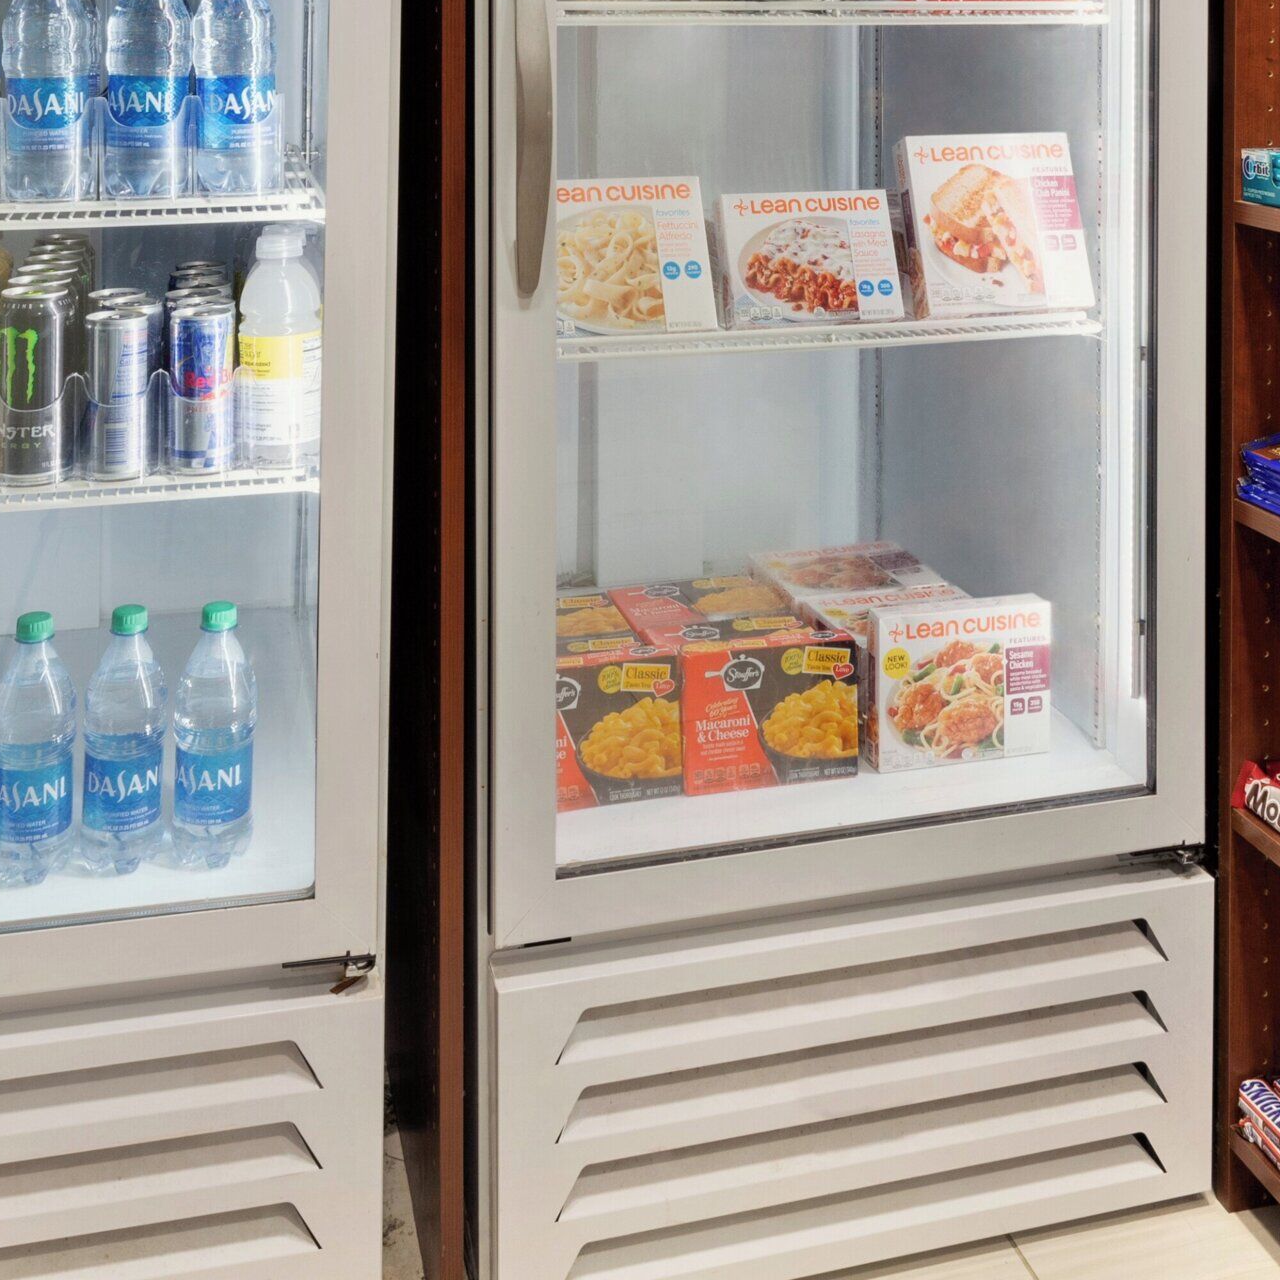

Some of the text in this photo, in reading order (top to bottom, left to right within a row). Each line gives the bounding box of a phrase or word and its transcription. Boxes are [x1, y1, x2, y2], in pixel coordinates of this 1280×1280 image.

[8, 88, 85, 121] DASANI
[930, 143, 1063, 163] Lean cuisine
[1243, 156, 1269, 179] Orbit
[605, 183, 691, 202] cuisine
[751, 196, 881, 215] Lean cuisine
[656, 208, 691, 218] favorites
[656, 220, 699, 231] Fettuccini
[658, 231, 693, 241] Alfredo
[851, 230, 886, 241] Lasagna
[867, 238, 888, 247] Meat
[854, 248, 878, 258] Sauce
[833, 594, 883, 606] Lean
[906, 611, 1041, 641] Lean cuisine
[1009, 635, 1046, 644] FEATURES
[807, 649, 847, 663] Classic
[887, 654, 905, 663] NEW
[1009, 650, 1034, 660] Sesame
[885, 661, 908, 671] LOOK!
[1009, 660, 1034, 669] Chicken
[624, 666, 668, 680] Classic
[728, 665, 761, 683] Stouffer's
[695, 716, 751, 732] Macaroni
[697, 727, 750, 744] & Cheese
